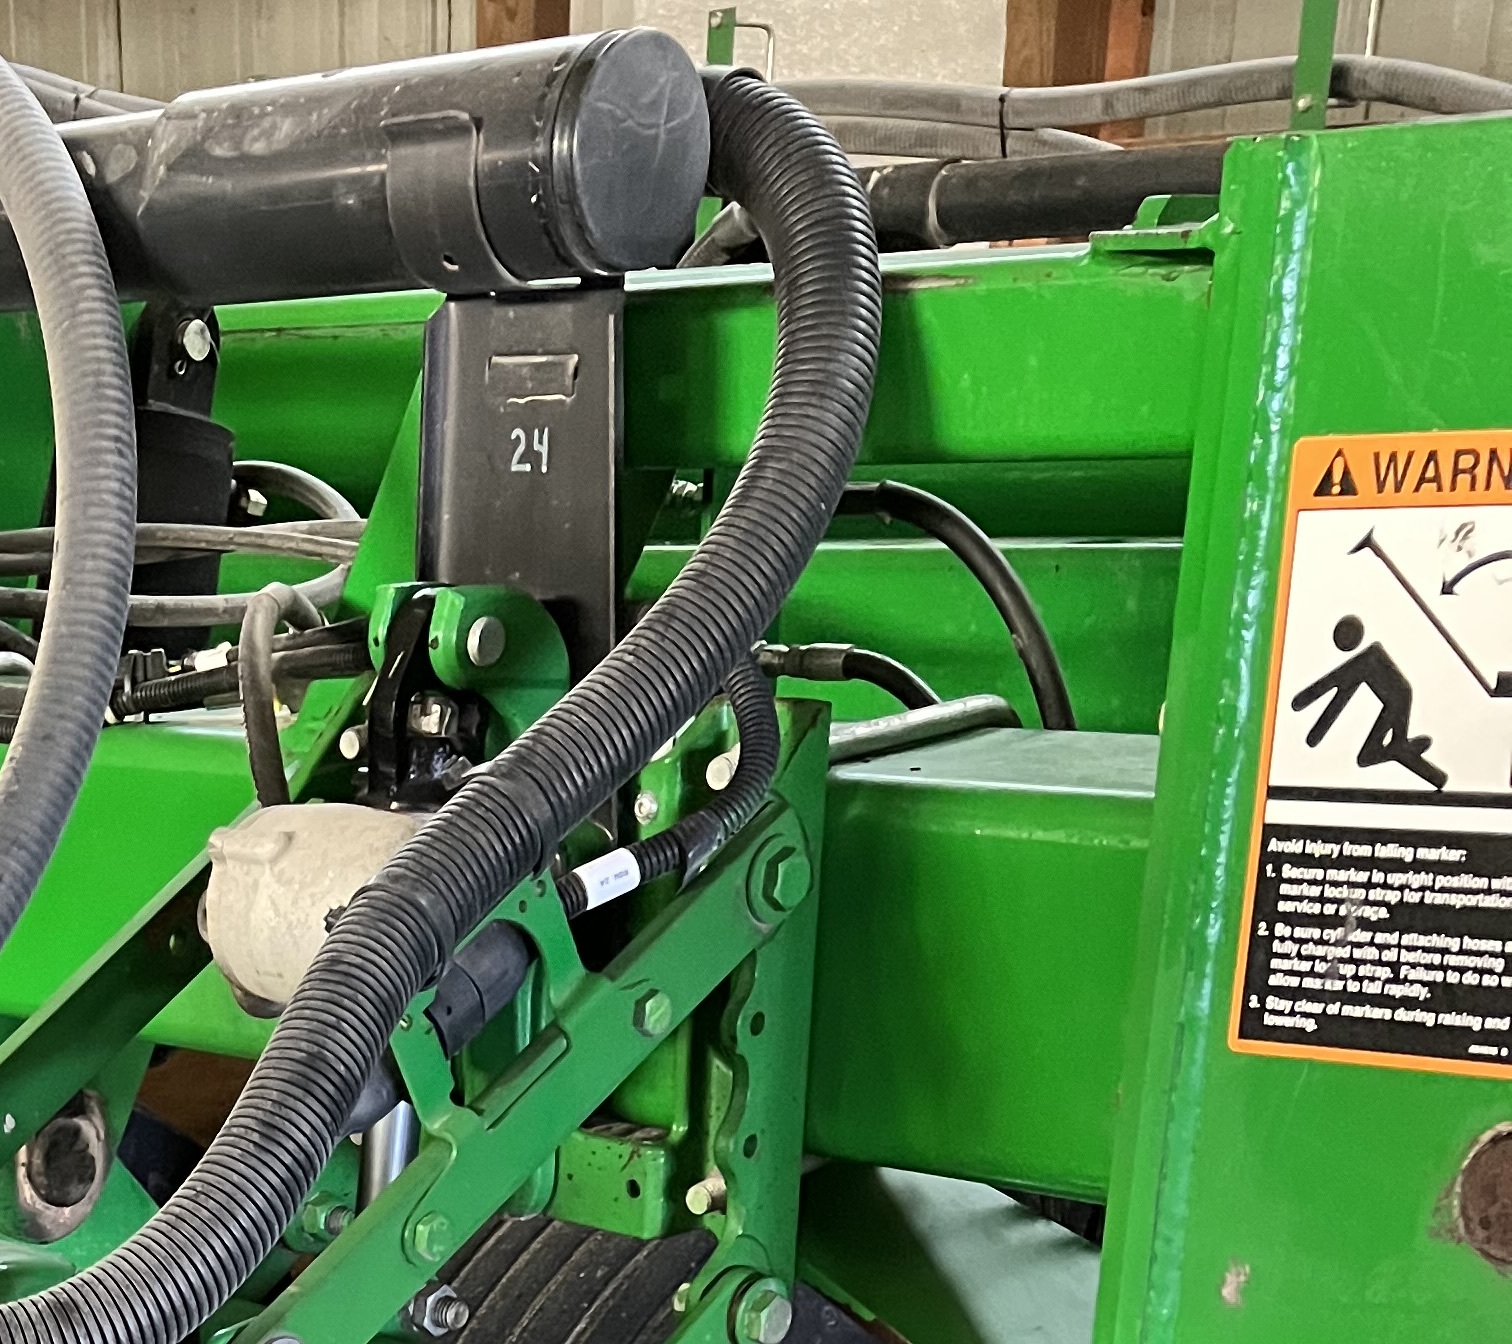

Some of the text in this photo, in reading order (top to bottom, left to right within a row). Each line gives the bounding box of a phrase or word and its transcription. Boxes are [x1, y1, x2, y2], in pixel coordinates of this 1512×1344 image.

[510, 427, 549, 474] 24
[1373, 447, 1512, 494] WARN
[1267, 837, 1304, 854] Avoid
[1343, 841, 1373, 858] from
[1374, 843, 1415, 863] falling
[1282, 863, 1325, 881] Secure
[1326, 867, 1371, 883] marker
[1371, 869, 1386, 884] in
[1386, 870, 1434, 889] upright
[1434, 873, 1490, 891] position
[1277, 899, 1322, 915] service
[1322, 903, 1338, 915] or
[1279, 882, 1323, 897] marker
[1367, 887, 1402, 906] strap
[1402, 888, 1424, 904] for
[1274, 922, 1293, 938] Be
[1293, 926, 1322, 940] sure
[1373, 931, 1400, 945] and
[1400, 932, 1461, 953] attaching
[1462, 935, 1503, 953] hoses
[1272, 938, 1506, 974] fully charged with oil before removing
[1267, 972, 1302, 988] allow
[1346, 979, 1361, 993] to
[1361, 979, 1383, 995] fall
[1269, 957, 1314, 972] marker
[1399, 964, 1445, 983] Failure
[1445, 969, 1461, 985] to
[1461, 970, 1481, 986] do
[1481, 973, 1500, 988] so
[1265, 994, 1294, 1014] Stay
[1293, 998, 1326, 1014] clear
[1325, 1001, 1341, 1016] of
[1340, 1004, 1393, 1021] markers
[1393, 1007, 1437, 1028] during
[1436, 1011, 1483, 1032] raising
[1483, 1016, 1511, 1031] and
